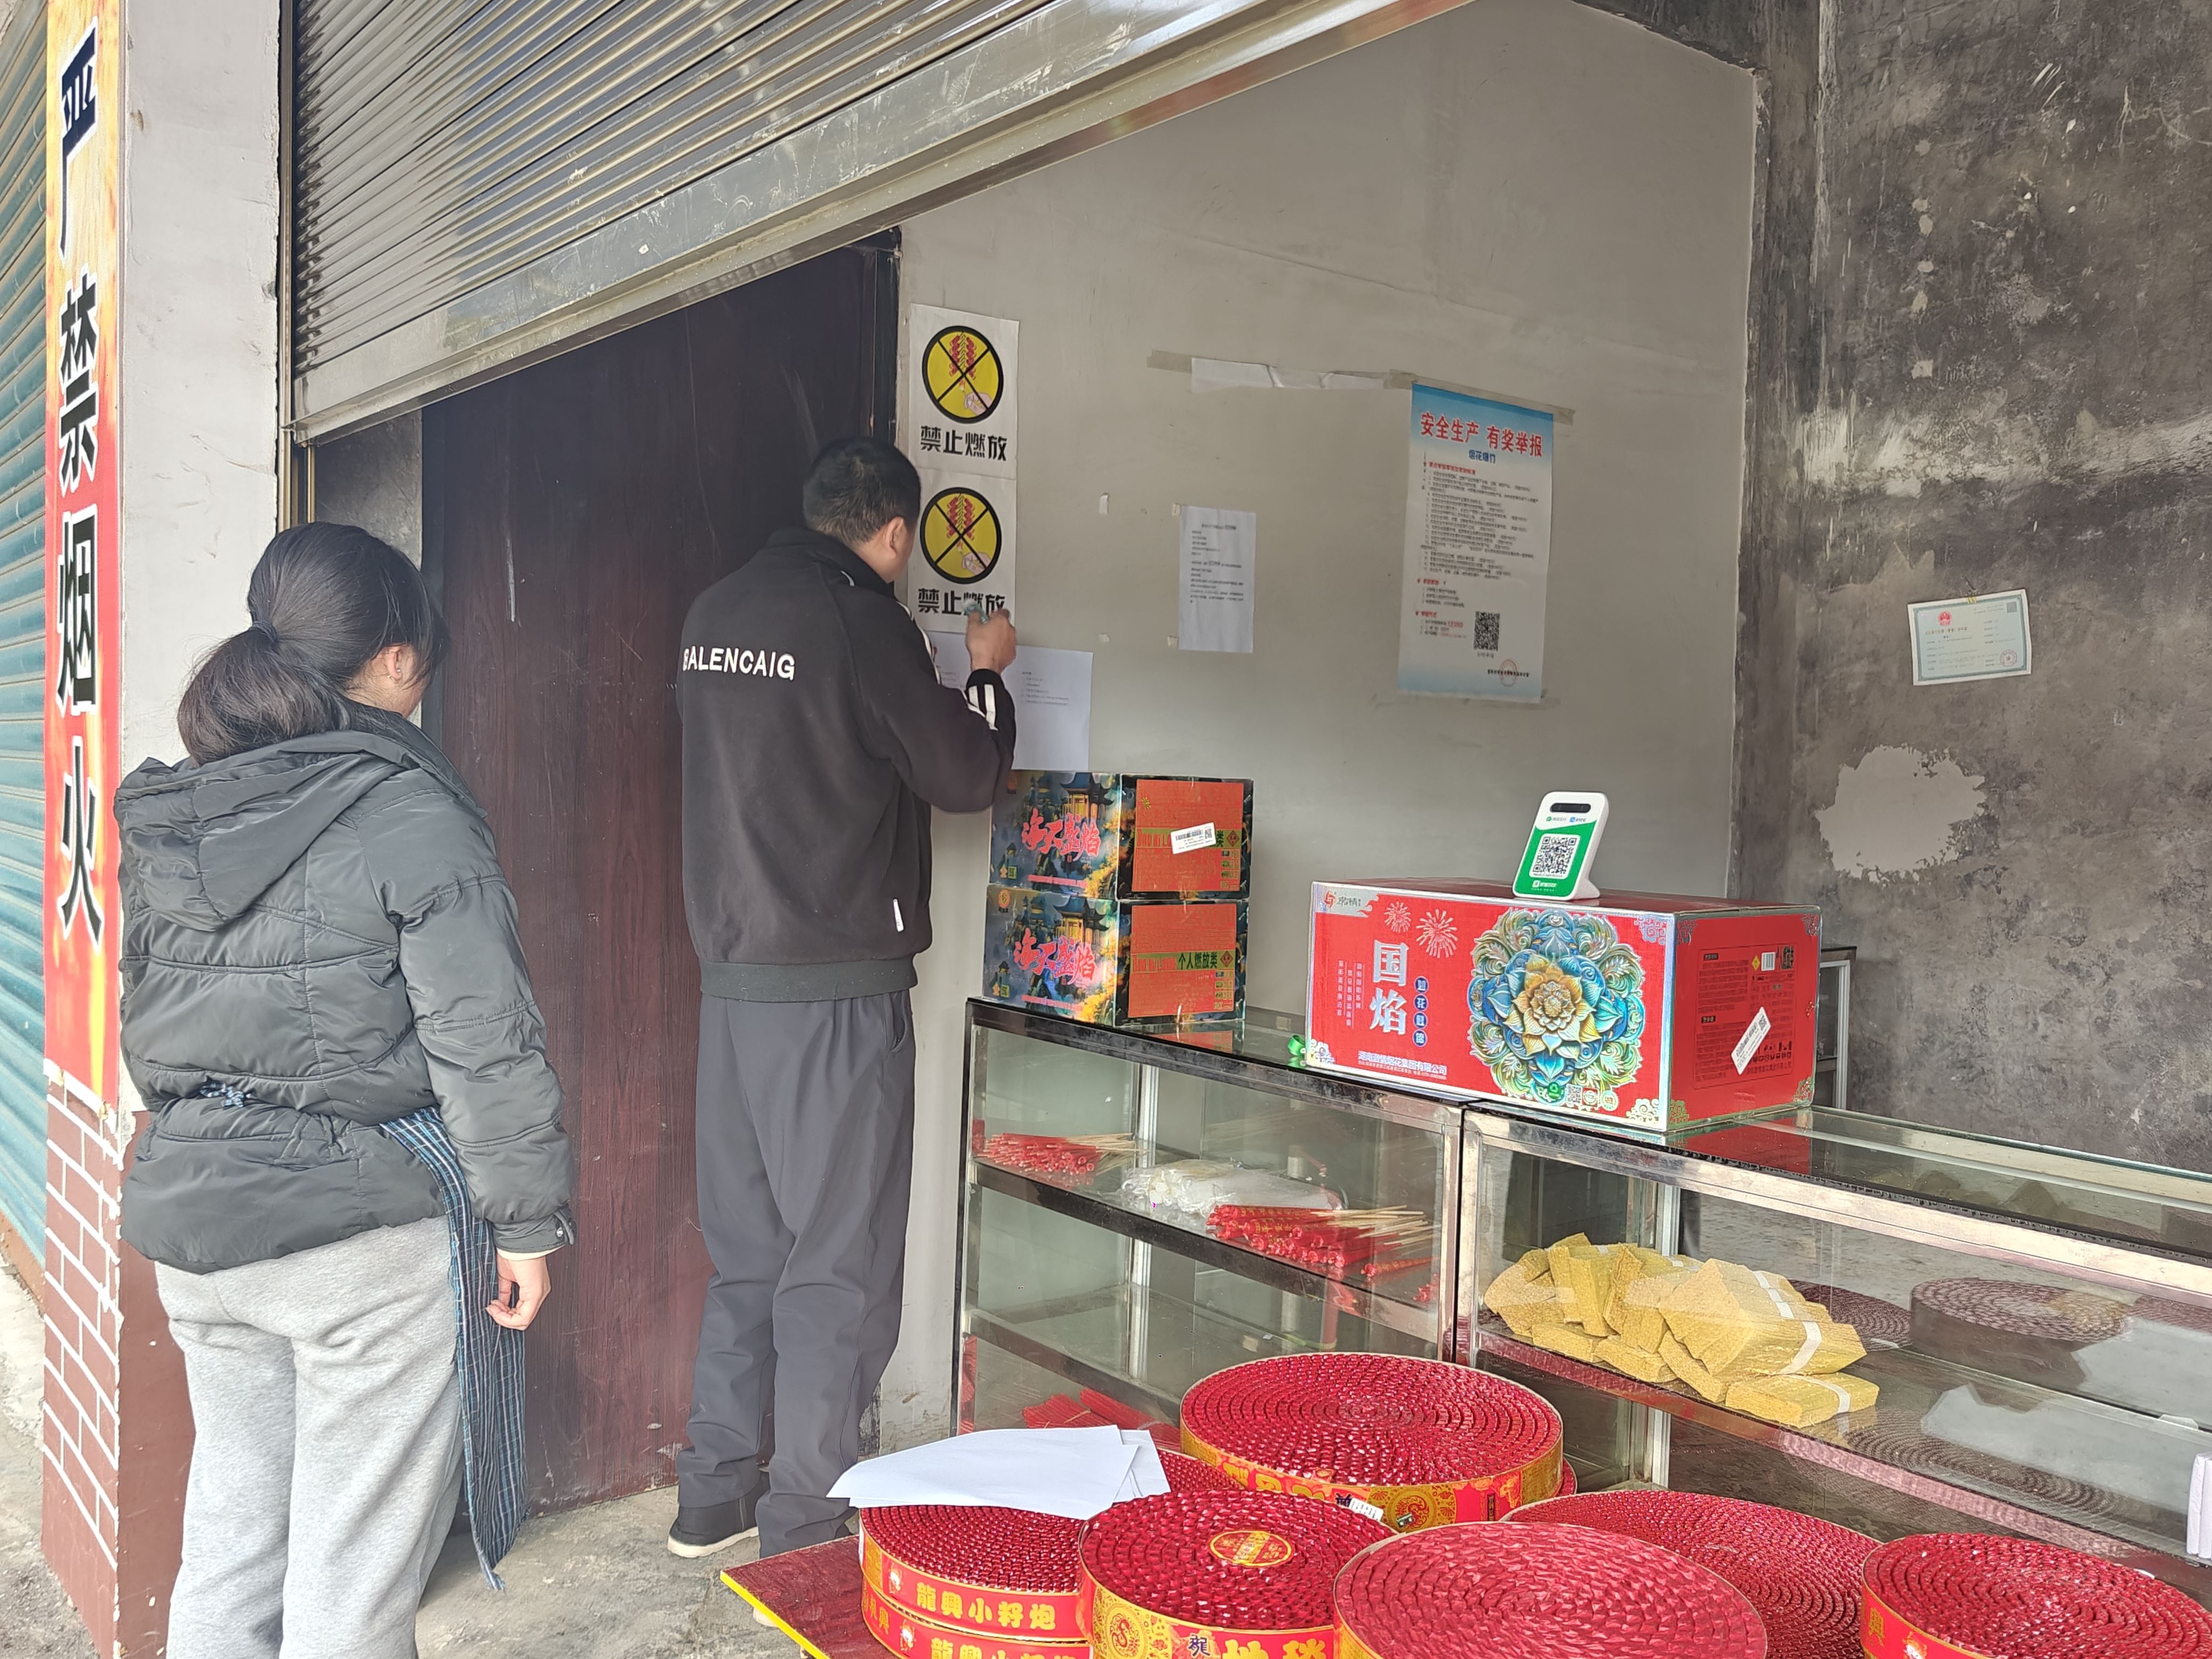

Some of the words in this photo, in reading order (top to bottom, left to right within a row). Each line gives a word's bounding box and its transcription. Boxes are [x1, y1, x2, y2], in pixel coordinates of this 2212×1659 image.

[920, 425, 1008, 462] 禁止燃放
[1420, 412, 1480, 444] 安全生产
[1486, 425, 1543, 458] 有奖举报
[57, 27, 102, 944] 严禁烟火
[1178, 951, 1218, 970] 个人燃放类
[1369, 939, 1410, 1036] 国焰
